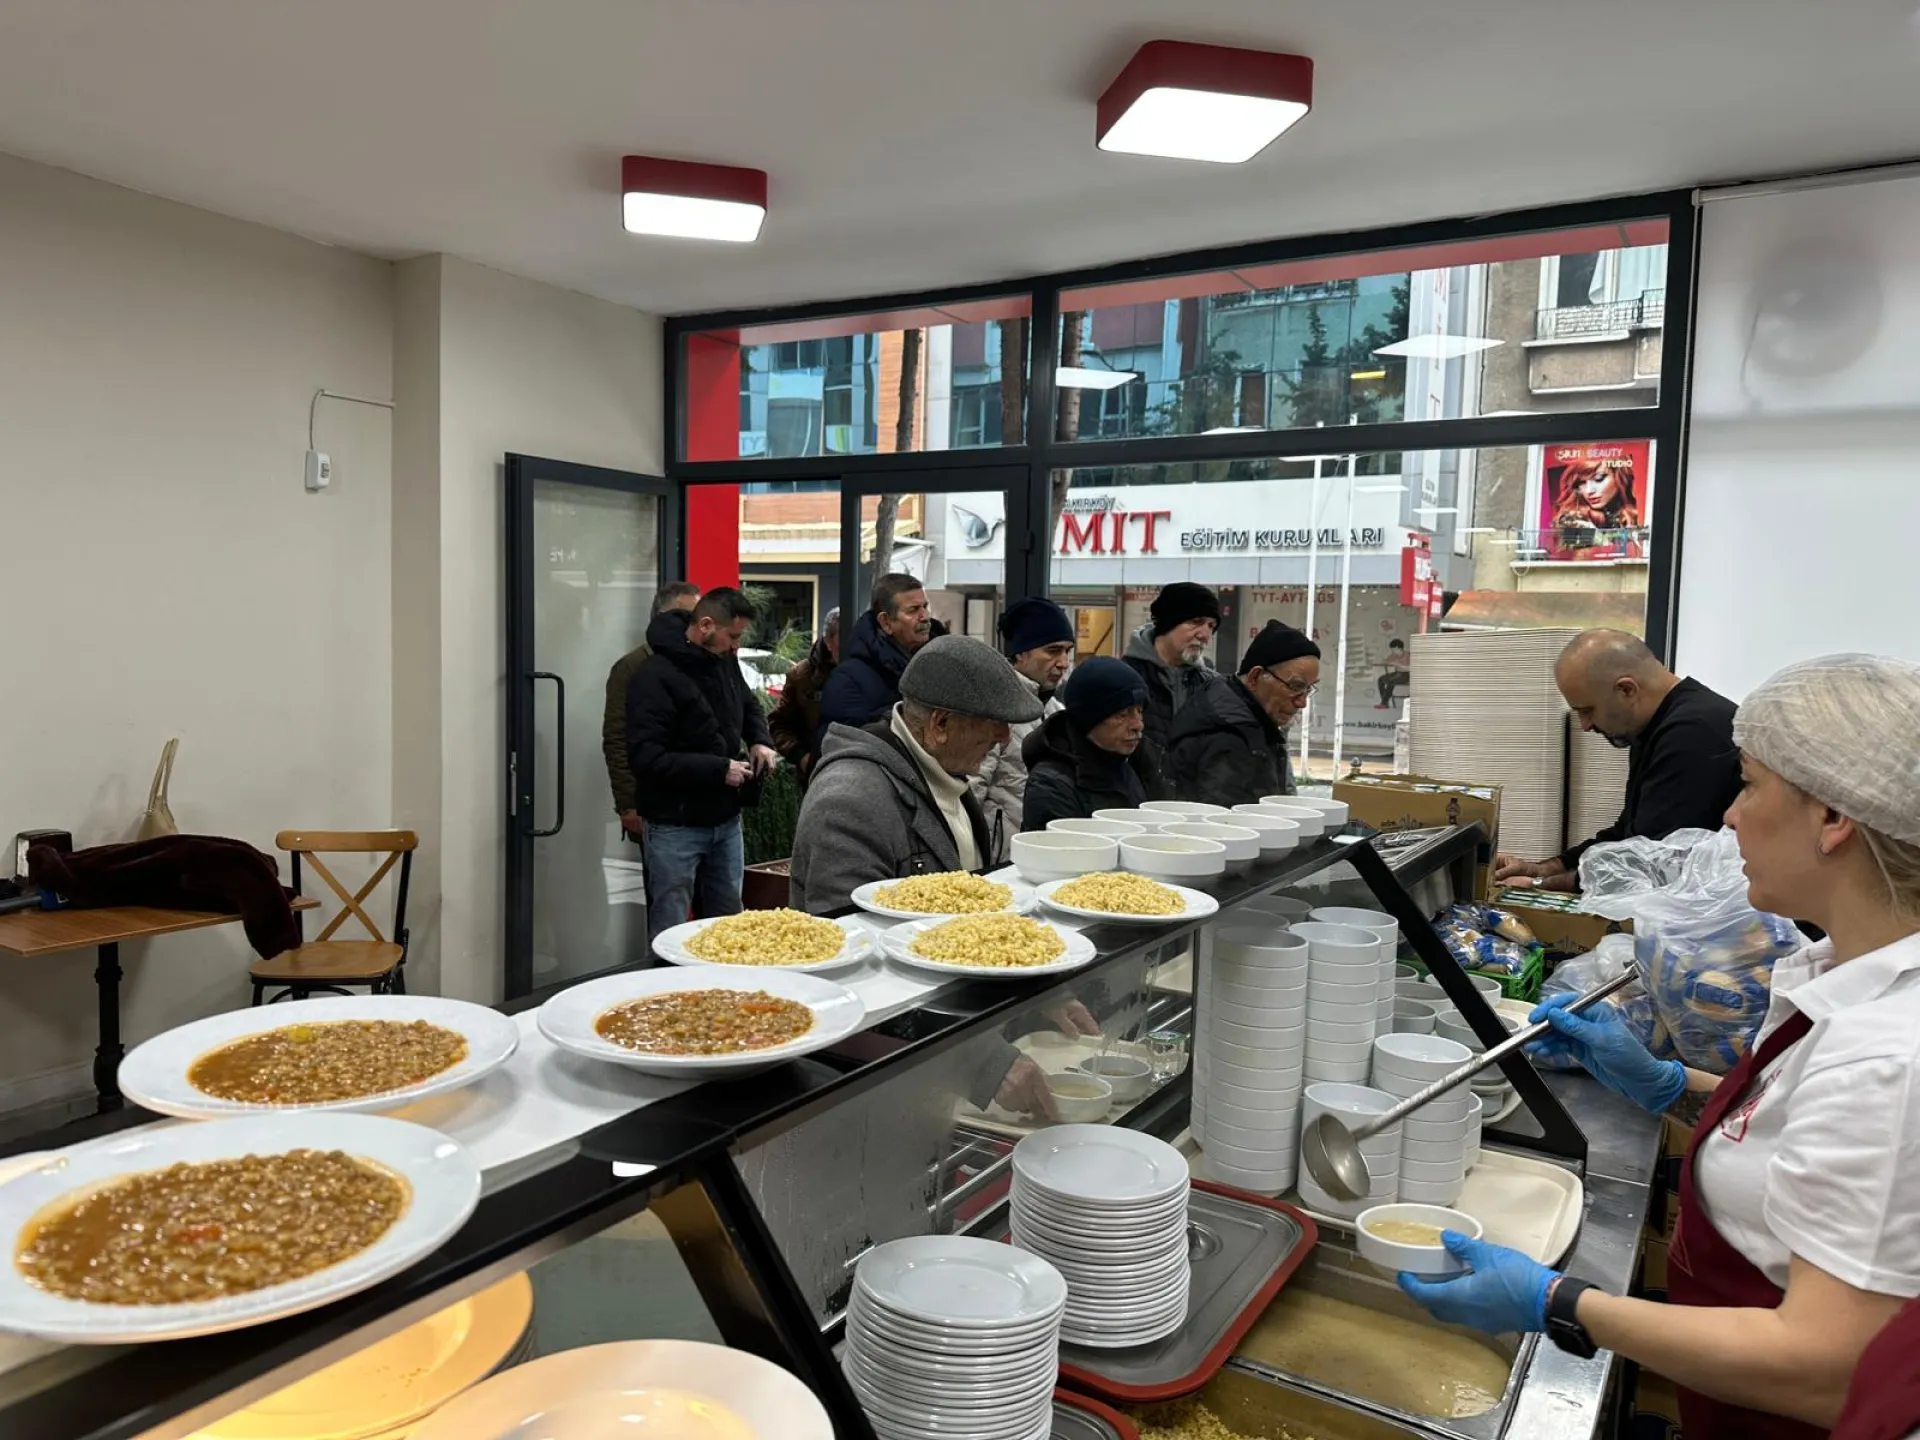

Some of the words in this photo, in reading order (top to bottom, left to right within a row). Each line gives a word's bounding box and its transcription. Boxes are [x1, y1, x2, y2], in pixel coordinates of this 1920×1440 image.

[1587, 448, 1623, 458] BEAUTY
[1601, 459, 1633, 468] STUDIO
[1063, 494, 1116, 511] AKIRKÖY
[1055, 508, 1172, 555] MİT
[1180, 528, 1250, 547] EĞİTİM
